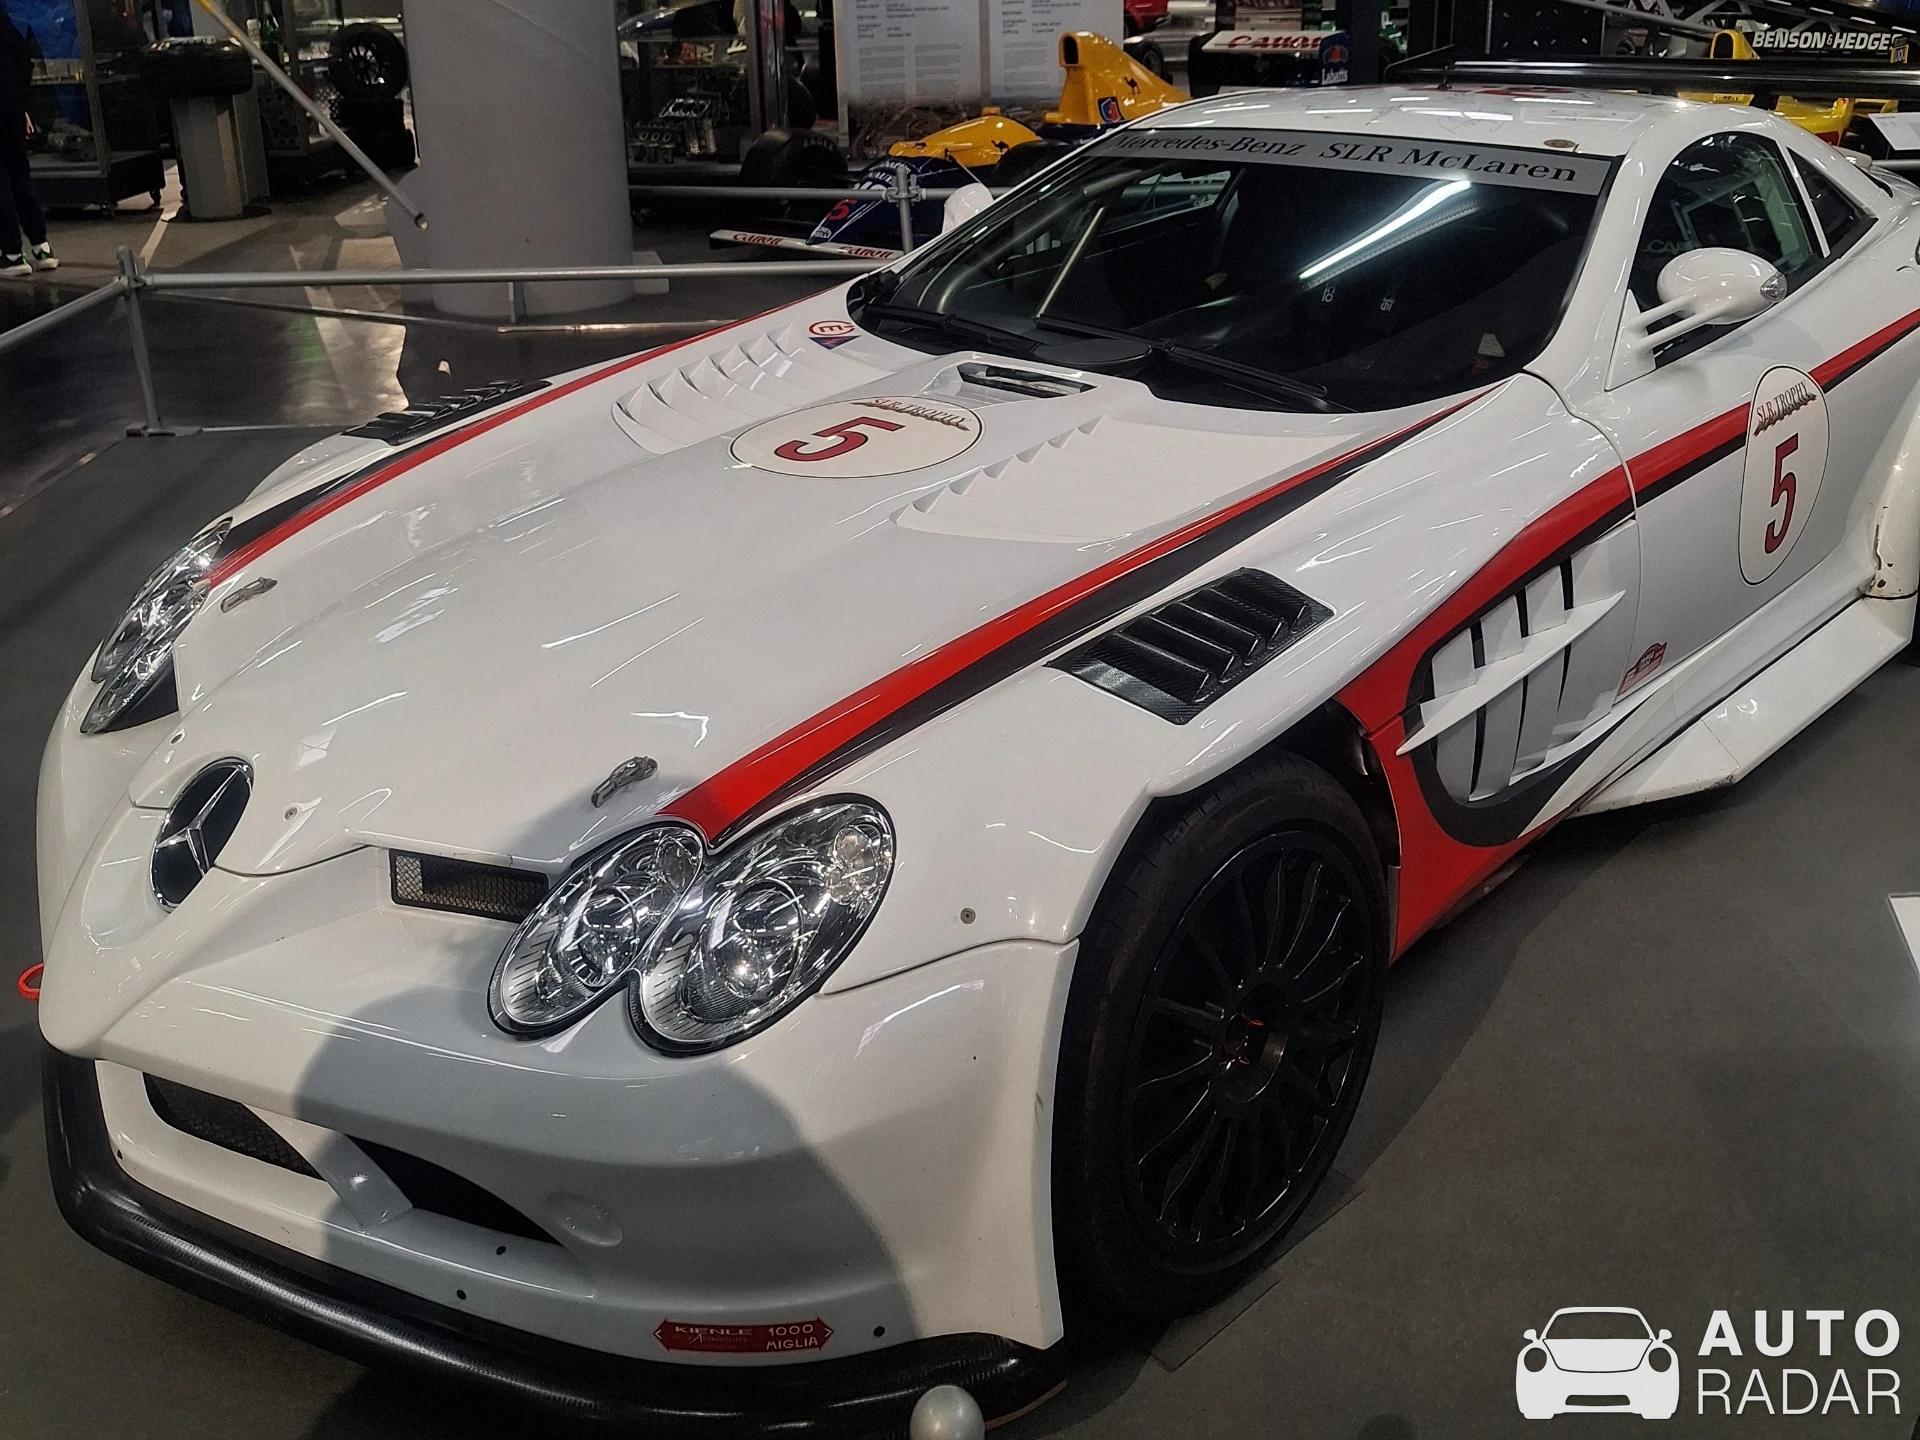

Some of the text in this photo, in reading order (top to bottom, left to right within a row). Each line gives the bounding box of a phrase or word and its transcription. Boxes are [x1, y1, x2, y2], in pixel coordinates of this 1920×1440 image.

[1107, 134, 1577, 183] Mercedes-Benz SLR McLaren
[826, 198, 857, 220] 5
[773, 416, 906, 462] 5
[1764, 432, 1799, 555] 5
[674, 1325, 753, 1336] KIENLE
[768, 1324, 814, 1337] 1000
[766, 1337, 818, 1350] MIGLIA
